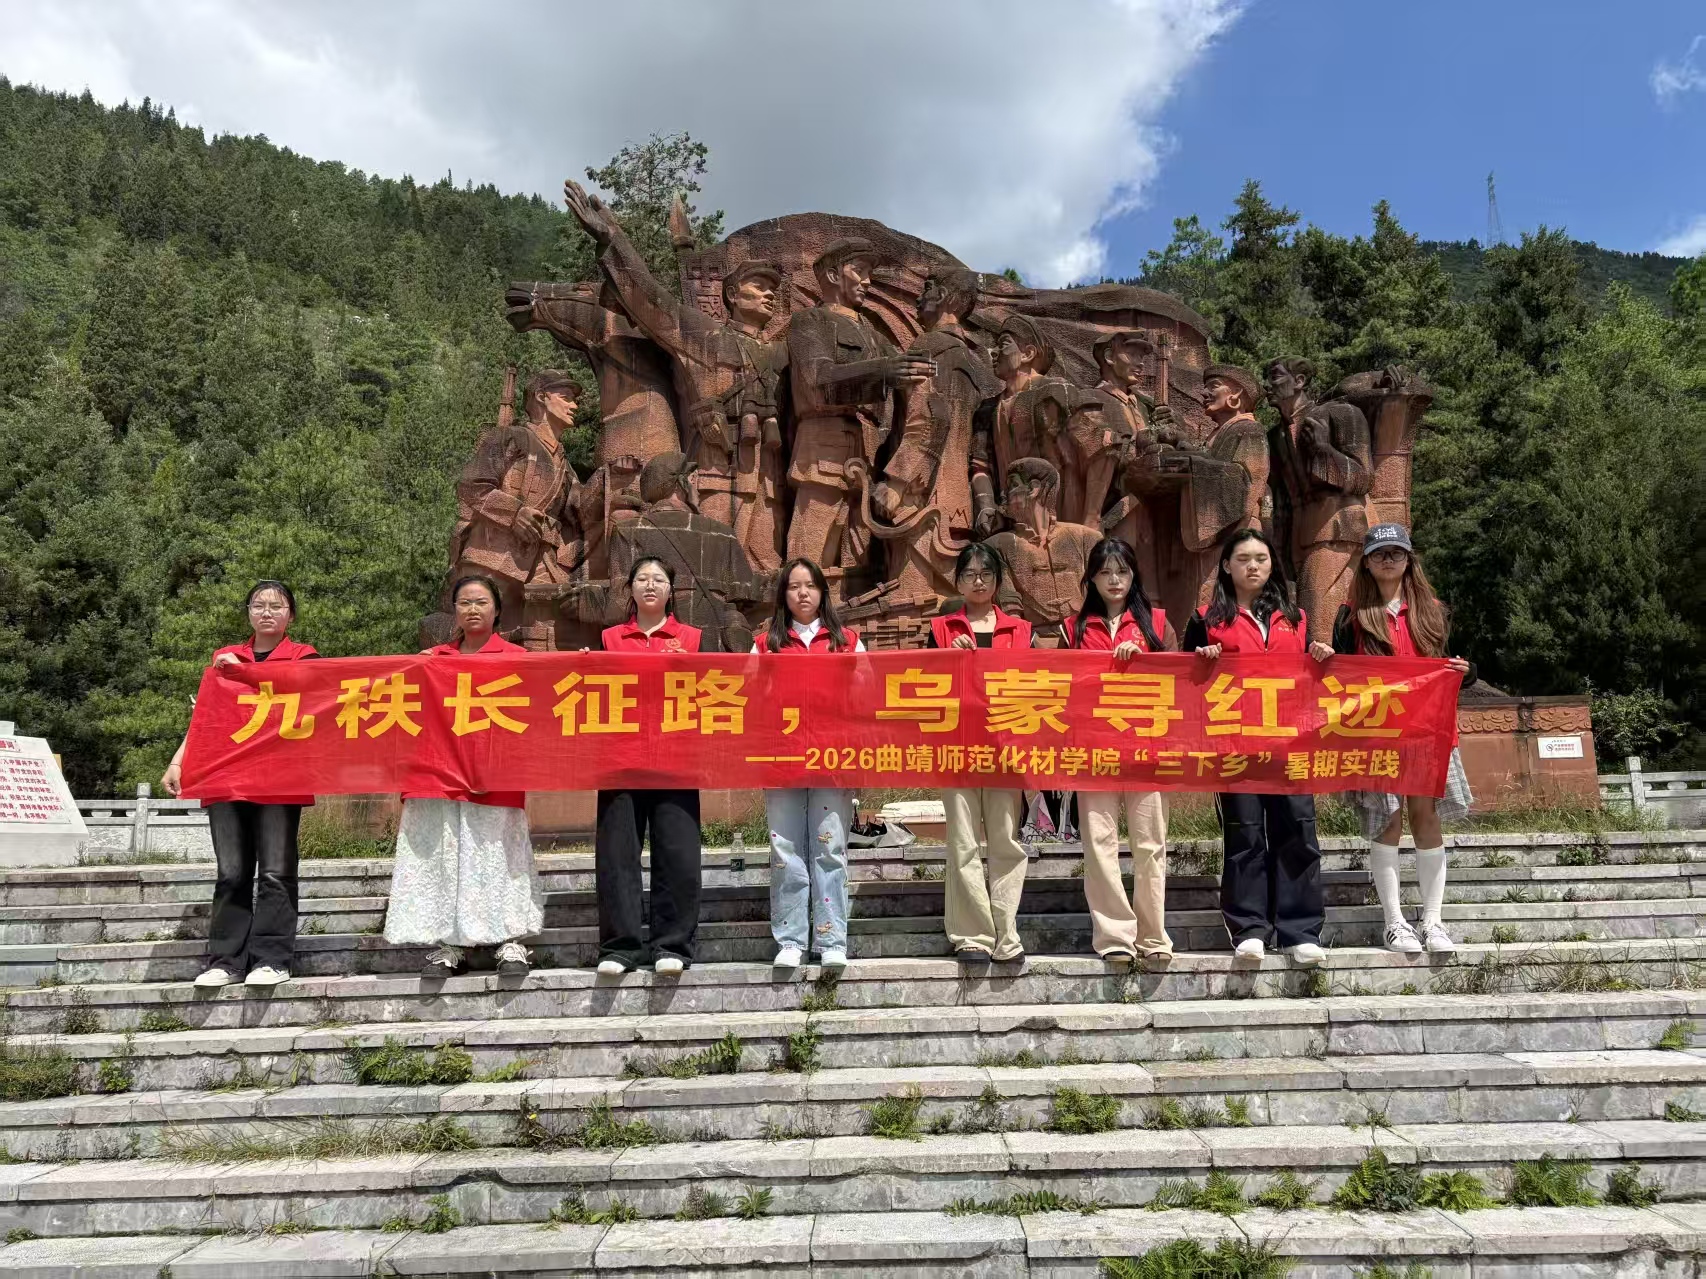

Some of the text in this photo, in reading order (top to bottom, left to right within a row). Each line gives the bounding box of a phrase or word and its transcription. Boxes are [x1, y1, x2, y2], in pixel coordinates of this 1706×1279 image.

[231, 669, 1409, 743] 九秩长征路，乌蒙寻红迹
